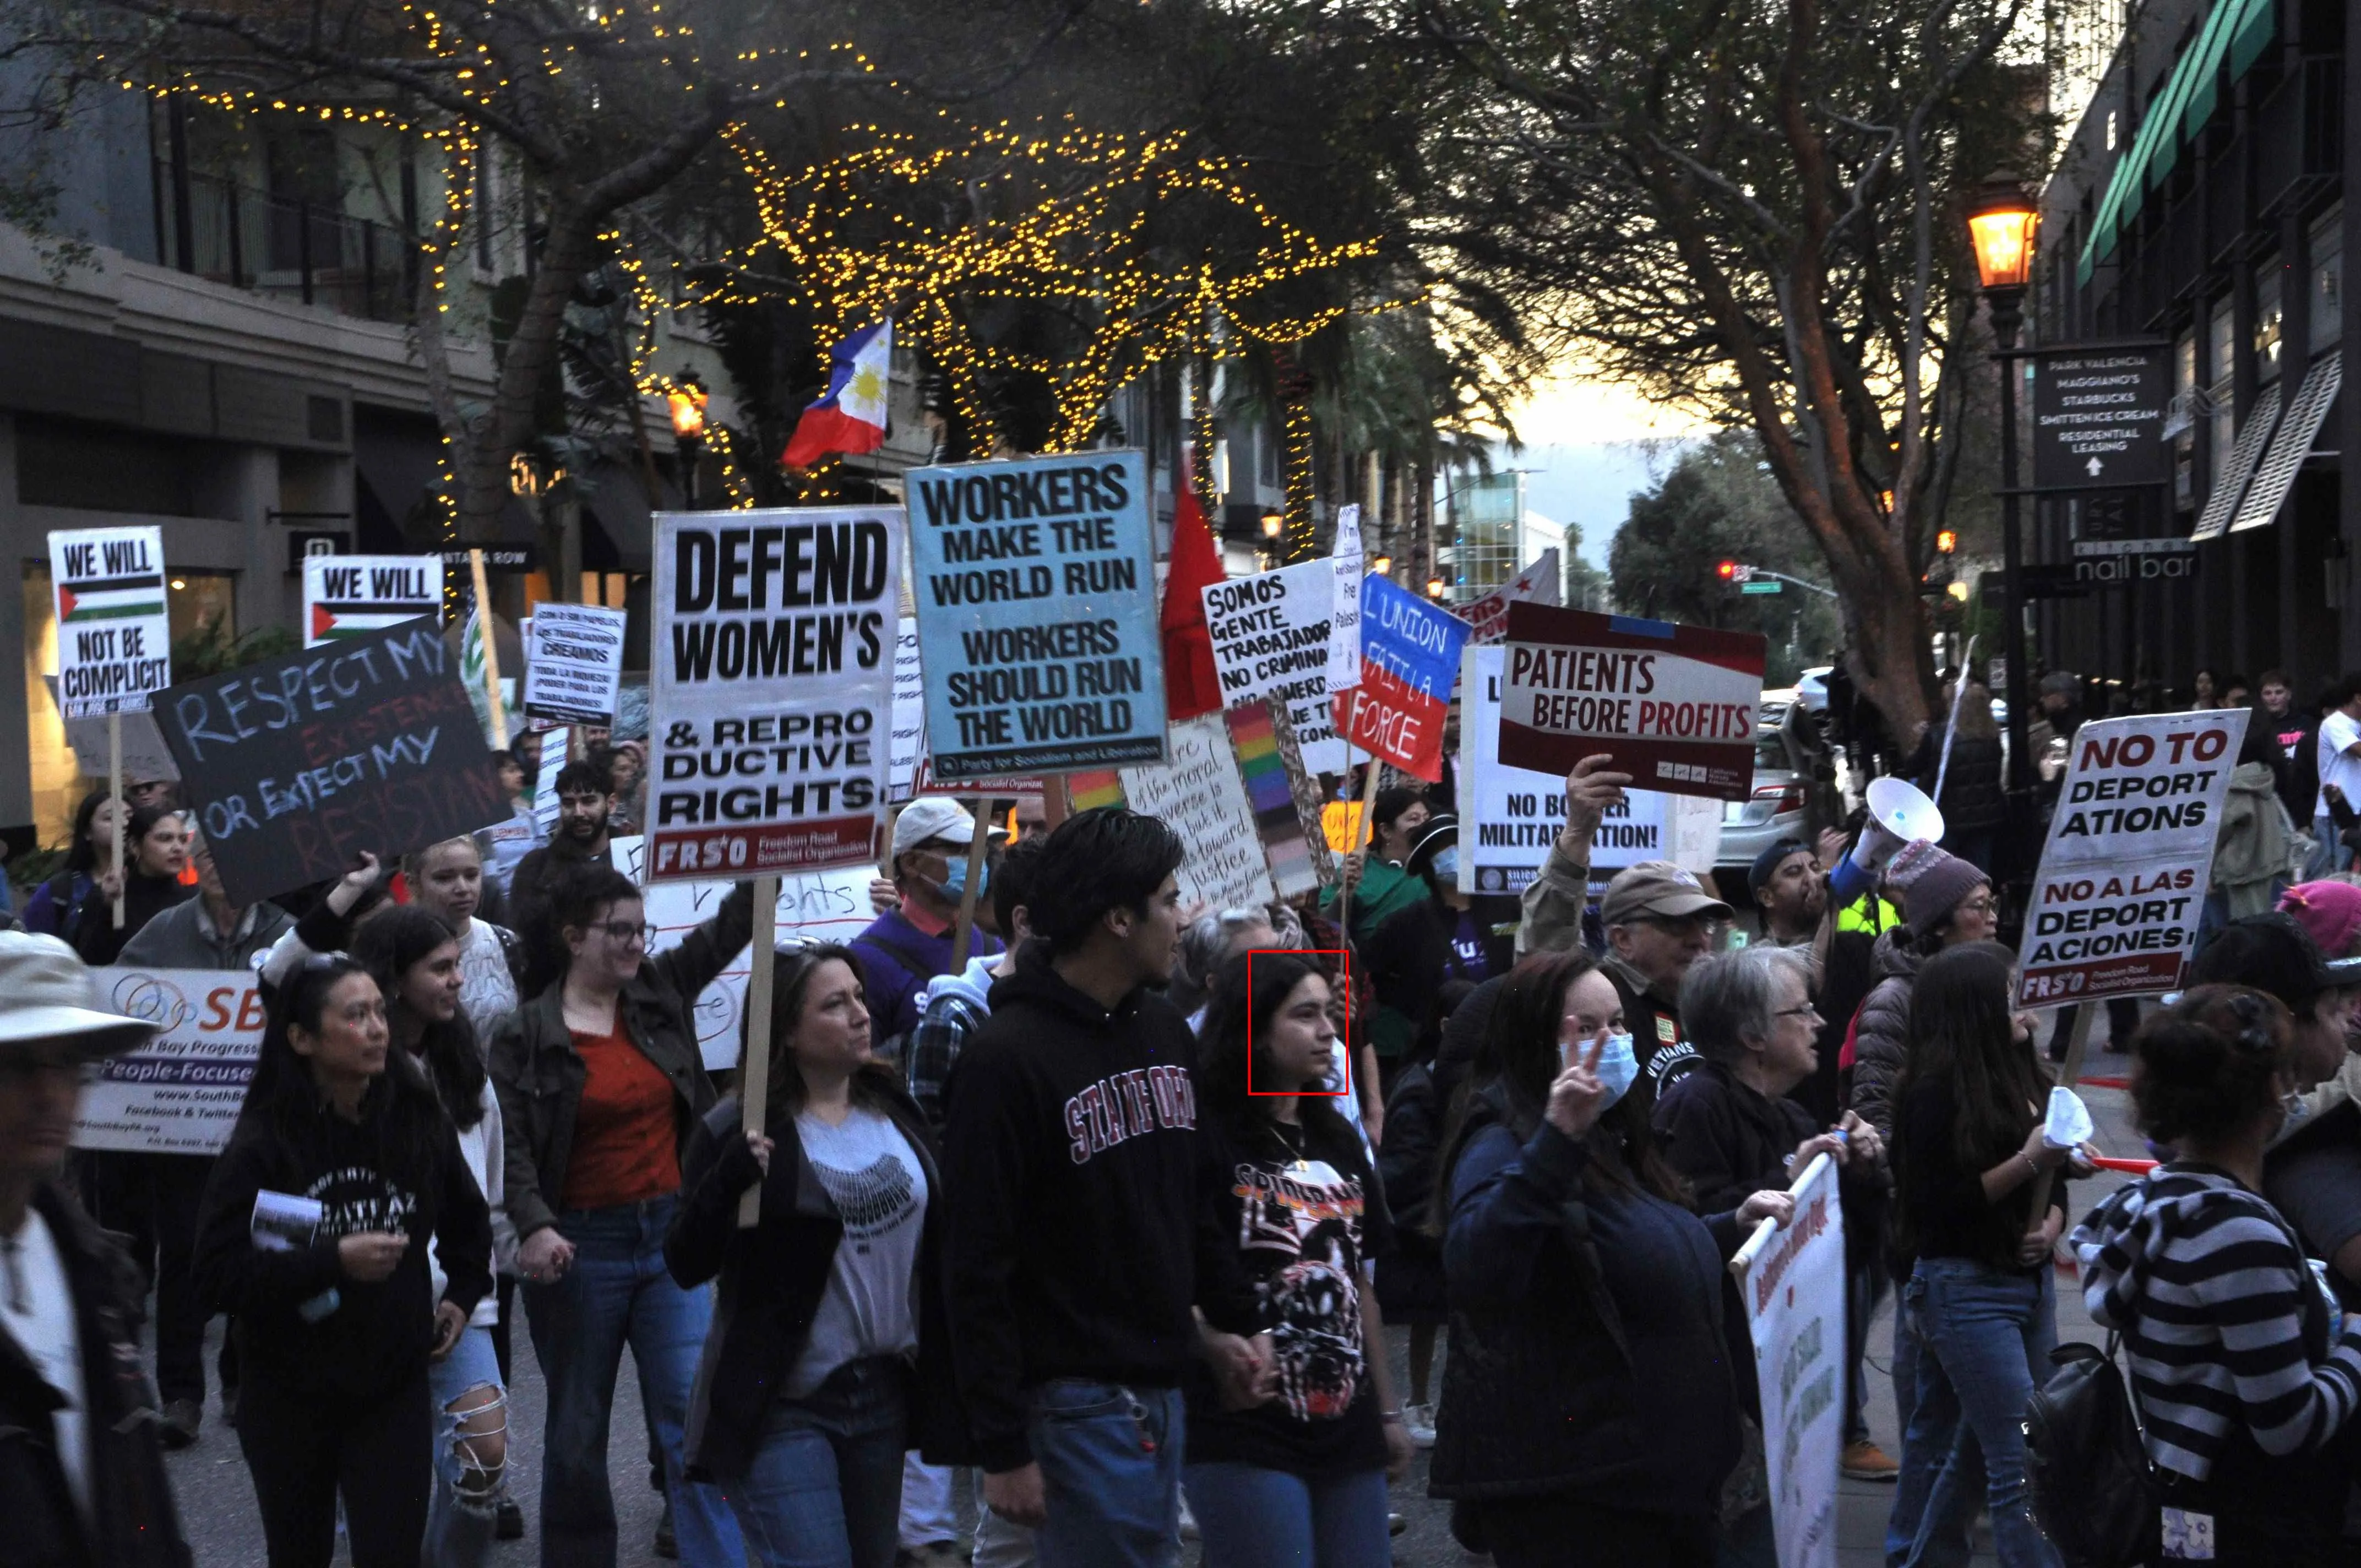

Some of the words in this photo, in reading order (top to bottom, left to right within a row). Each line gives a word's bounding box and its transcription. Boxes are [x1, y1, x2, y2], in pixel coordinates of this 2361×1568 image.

[2057, 374, 2141, 389] MAGGIANO'S
[2062, 392, 2136, 406] STARBUCKS
[2039, 413, 2093, 425] SMITTEN
[2114, 410, 2159, 421] CREAM
[2058, 428, 2141, 442] RESIDENTIAL
[2071, 440, 2128, 453] LEASING
[918, 463, 1129, 527] WORKERS
[64, 543, 95, 578] WE
[102, 539, 153, 573] WILL
[942, 524, 1042, 564] MAKE
[1049, 517, 1117, 553] THE
[324, 568, 362, 599] WE
[371, 567, 429, 598] WILL
[675, 520, 888, 614] DEFEND
[930, 564, 1052, 607] WORLD
[1064, 557, 1137, 596] RUN
[2075, 554, 2130, 581] nail
[2139, 554, 2194, 578] bar
[1207, 575, 1286, 619] SOMOS
[1211, 605, 1290, 641] GENTE
[77, 629, 115, 661] NOT
[123, 626, 144, 656] BE
[542, 643, 608, 663] CREAMOS
[672, 612, 883, 684] WOMEN'S
[961, 619, 1120, 667] WORKERS
[65, 659, 166, 698] COMPLICIT
[947, 664, 1068, 708] SHOULD
[1074, 657, 1143, 698] RUN
[1221, 668, 1251, 691] NO
[1256, 647, 1328, 681] CRIMINA
[1363, 641, 1410, 694] FAIT
[1511, 647, 1656, 694] PATIENTS
[173, 647, 381, 763] RESPECT
[385, 629, 445, 680] MY
[592, 685, 608, 694] LOS
[664, 720, 699, 749] &
[713, 707, 873, 747] REPRO
[954, 707, 1013, 748] THE
[1019, 699, 1132, 742] WORLD
[1350, 691, 1421, 760] FORCE
[1532, 693, 1633, 733] BEFORE
[1637, 701, 1751, 739] PROFITS
[662, 741, 872, 782] DUCTIVE
[1073, 749, 1098, 761] and
[1171, 739, 1222, 797] moral
[2080, 734, 2155, 771] NO
[2166, 729, 2228, 764] TO
[205, 794, 259, 840] OR
[372, 726, 439, 780] MY
[659, 777, 874, 825] RIGHTS
[1009, 778, 1043, 790] Organizat
[2069, 770, 2217, 803] DEPORT
[1185, 809, 1211, 838] but
[1213, 800, 1227, 823] it
[1507, 793, 1537, 818] NO
[1545, 793, 1630, 818] BOER
[2059, 801, 2207, 838] ATIONS
[759, 834, 807, 851] Freedom
[809, 830, 837, 846] Road
[1196, 807, 1248, 863] toward
[757, 847, 802, 865] Socialist
[2044, 880, 2095, 904] NO
[2099, 877, 2125, 899] A
[2130, 869, 2194, 895] LAS
[2036, 897, 2191, 936] DEPORT
[2030, 927, 2184, 964] ACIONES
[2127, 965, 2149, 974] Road
[157, 1041, 187, 1056] Bay
[190, 1041, 259, 1055] Progress
[101, 1059, 254, 1084] People-Focuse
[124, 1104, 181, 1117] Facebook
